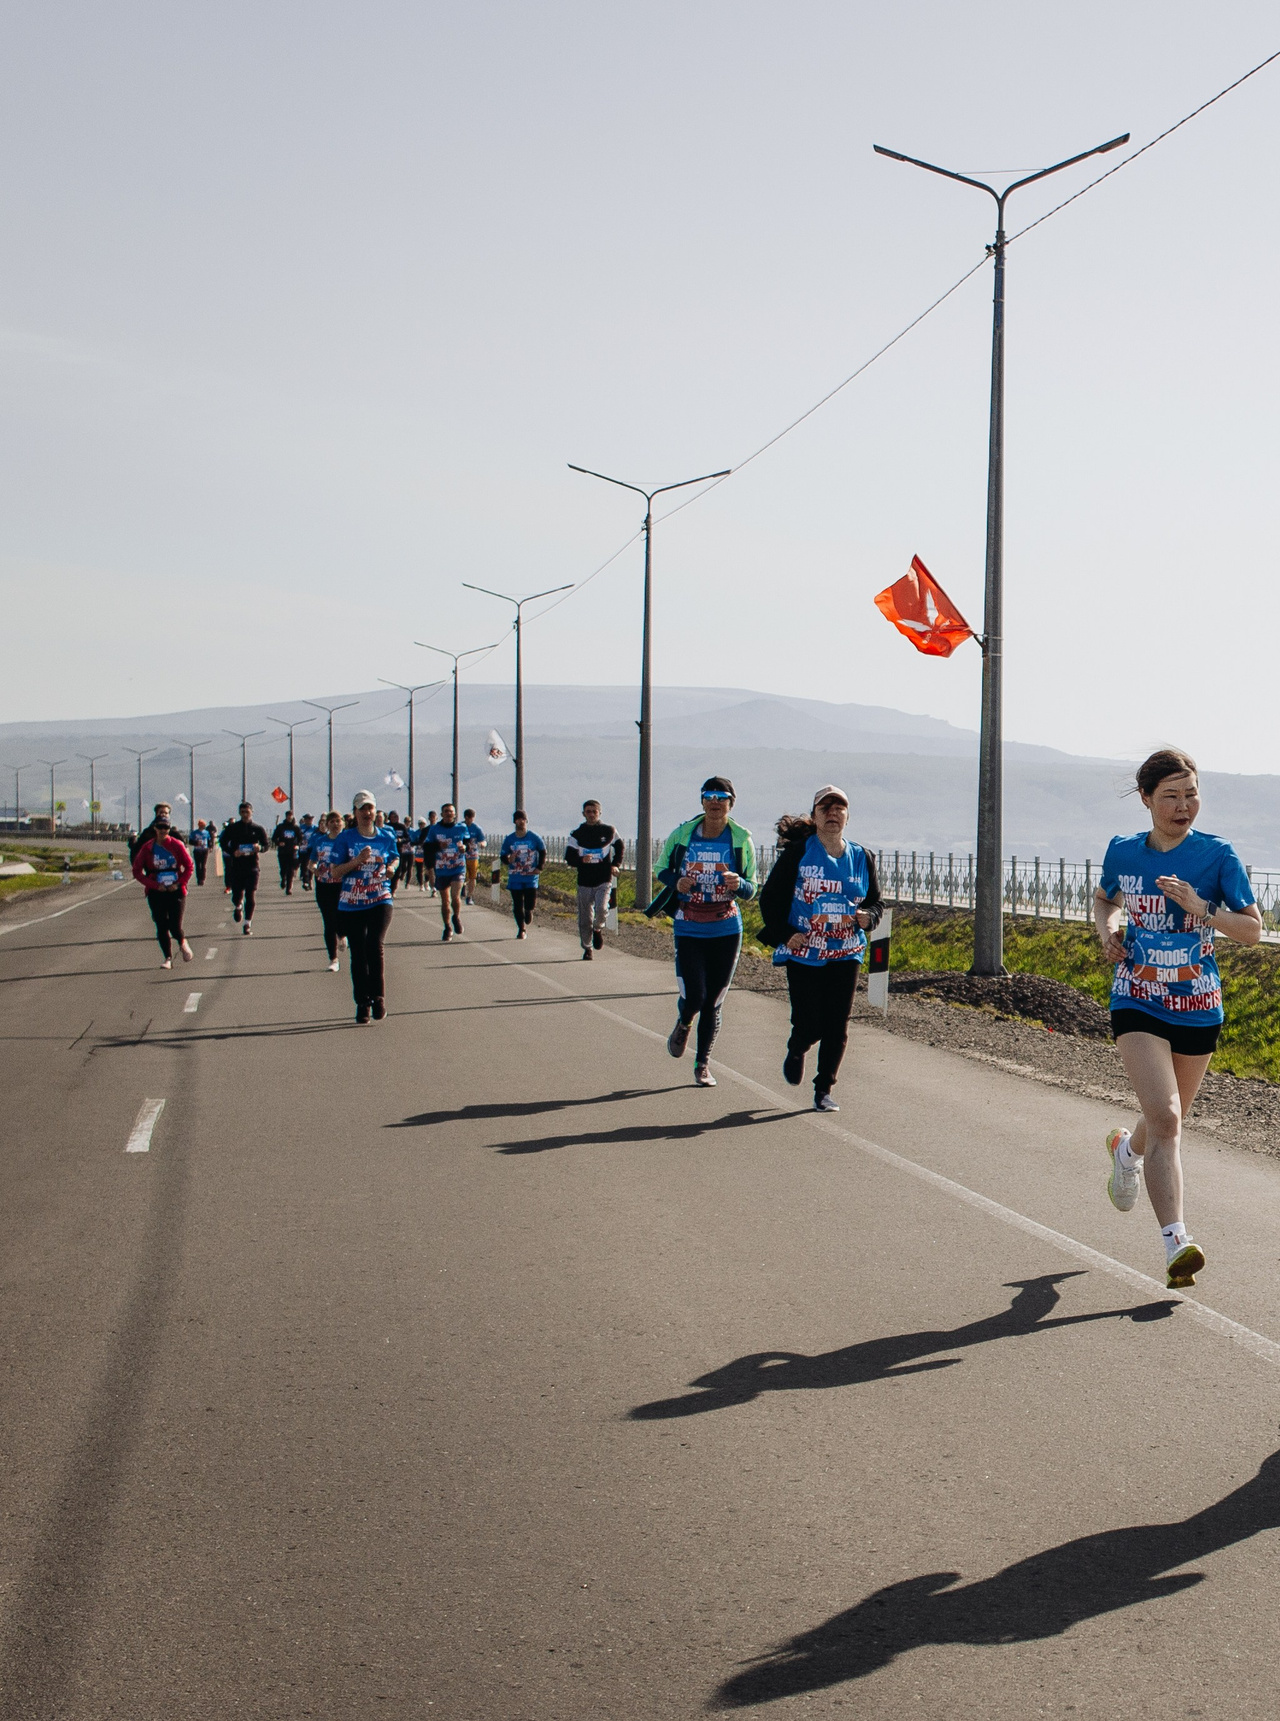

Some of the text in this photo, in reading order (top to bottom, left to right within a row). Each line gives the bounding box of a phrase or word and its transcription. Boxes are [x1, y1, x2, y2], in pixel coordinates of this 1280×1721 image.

[1118, 875, 1144, 894] 2024
[822, 903, 847, 913] 20031
[1147, 948, 1188, 967] 20005
[1191, 972, 1217, 995] 2024
